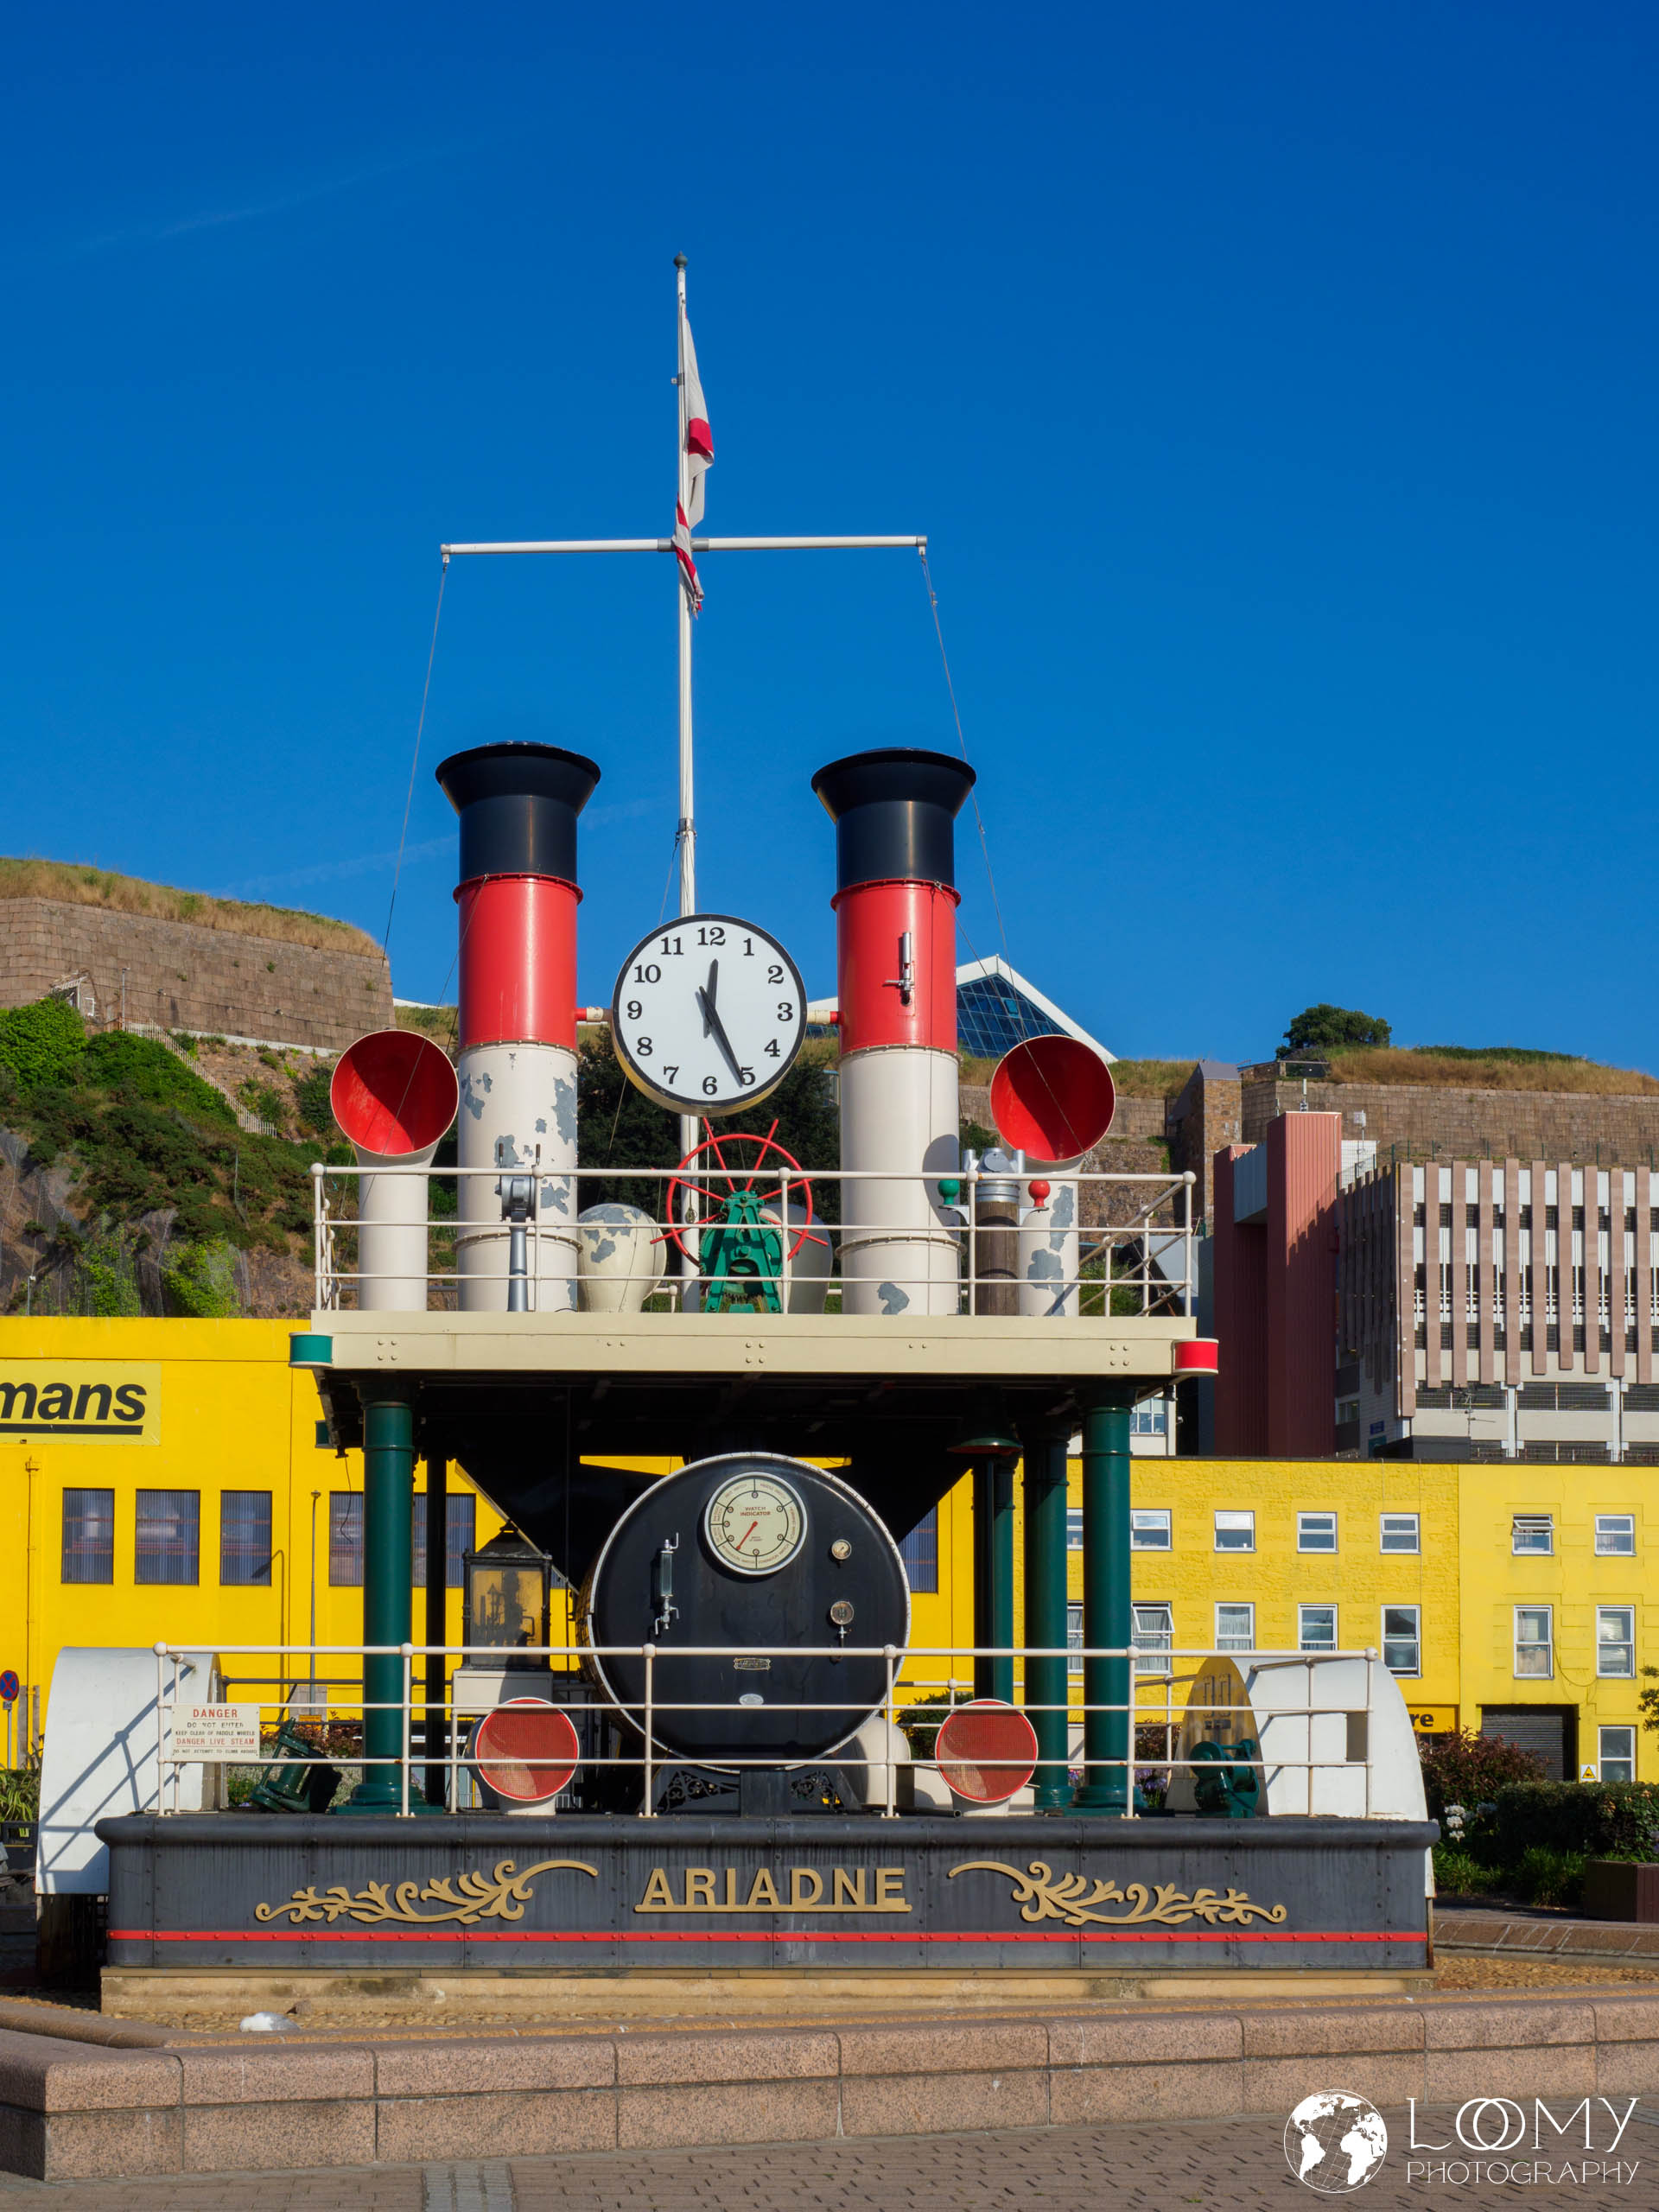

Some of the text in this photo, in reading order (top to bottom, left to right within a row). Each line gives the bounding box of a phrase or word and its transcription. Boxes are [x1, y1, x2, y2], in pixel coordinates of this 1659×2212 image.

[697, 927, 726, 946] 12
[660, 937, 684, 956] 11
[743, 938, 754, 956] 1
[634, 964, 661, 983] 10
[768, 965, 785, 984] 2
[626, 1001, 643, 1020] 9
[777, 1002, 793, 1021] 3
[637, 1037, 653, 1056] 8
[764, 1039, 780, 1058] 4
[663, 1065, 679, 1084] 7
[741, 1066, 756, 1085] 5
[702, 1076, 718, 1095] 6
[0, 1382, 147, 1422] mans
[193, 1708, 238, 1718] DANGER
[641, 1867, 906, 1905] ARIADNE
